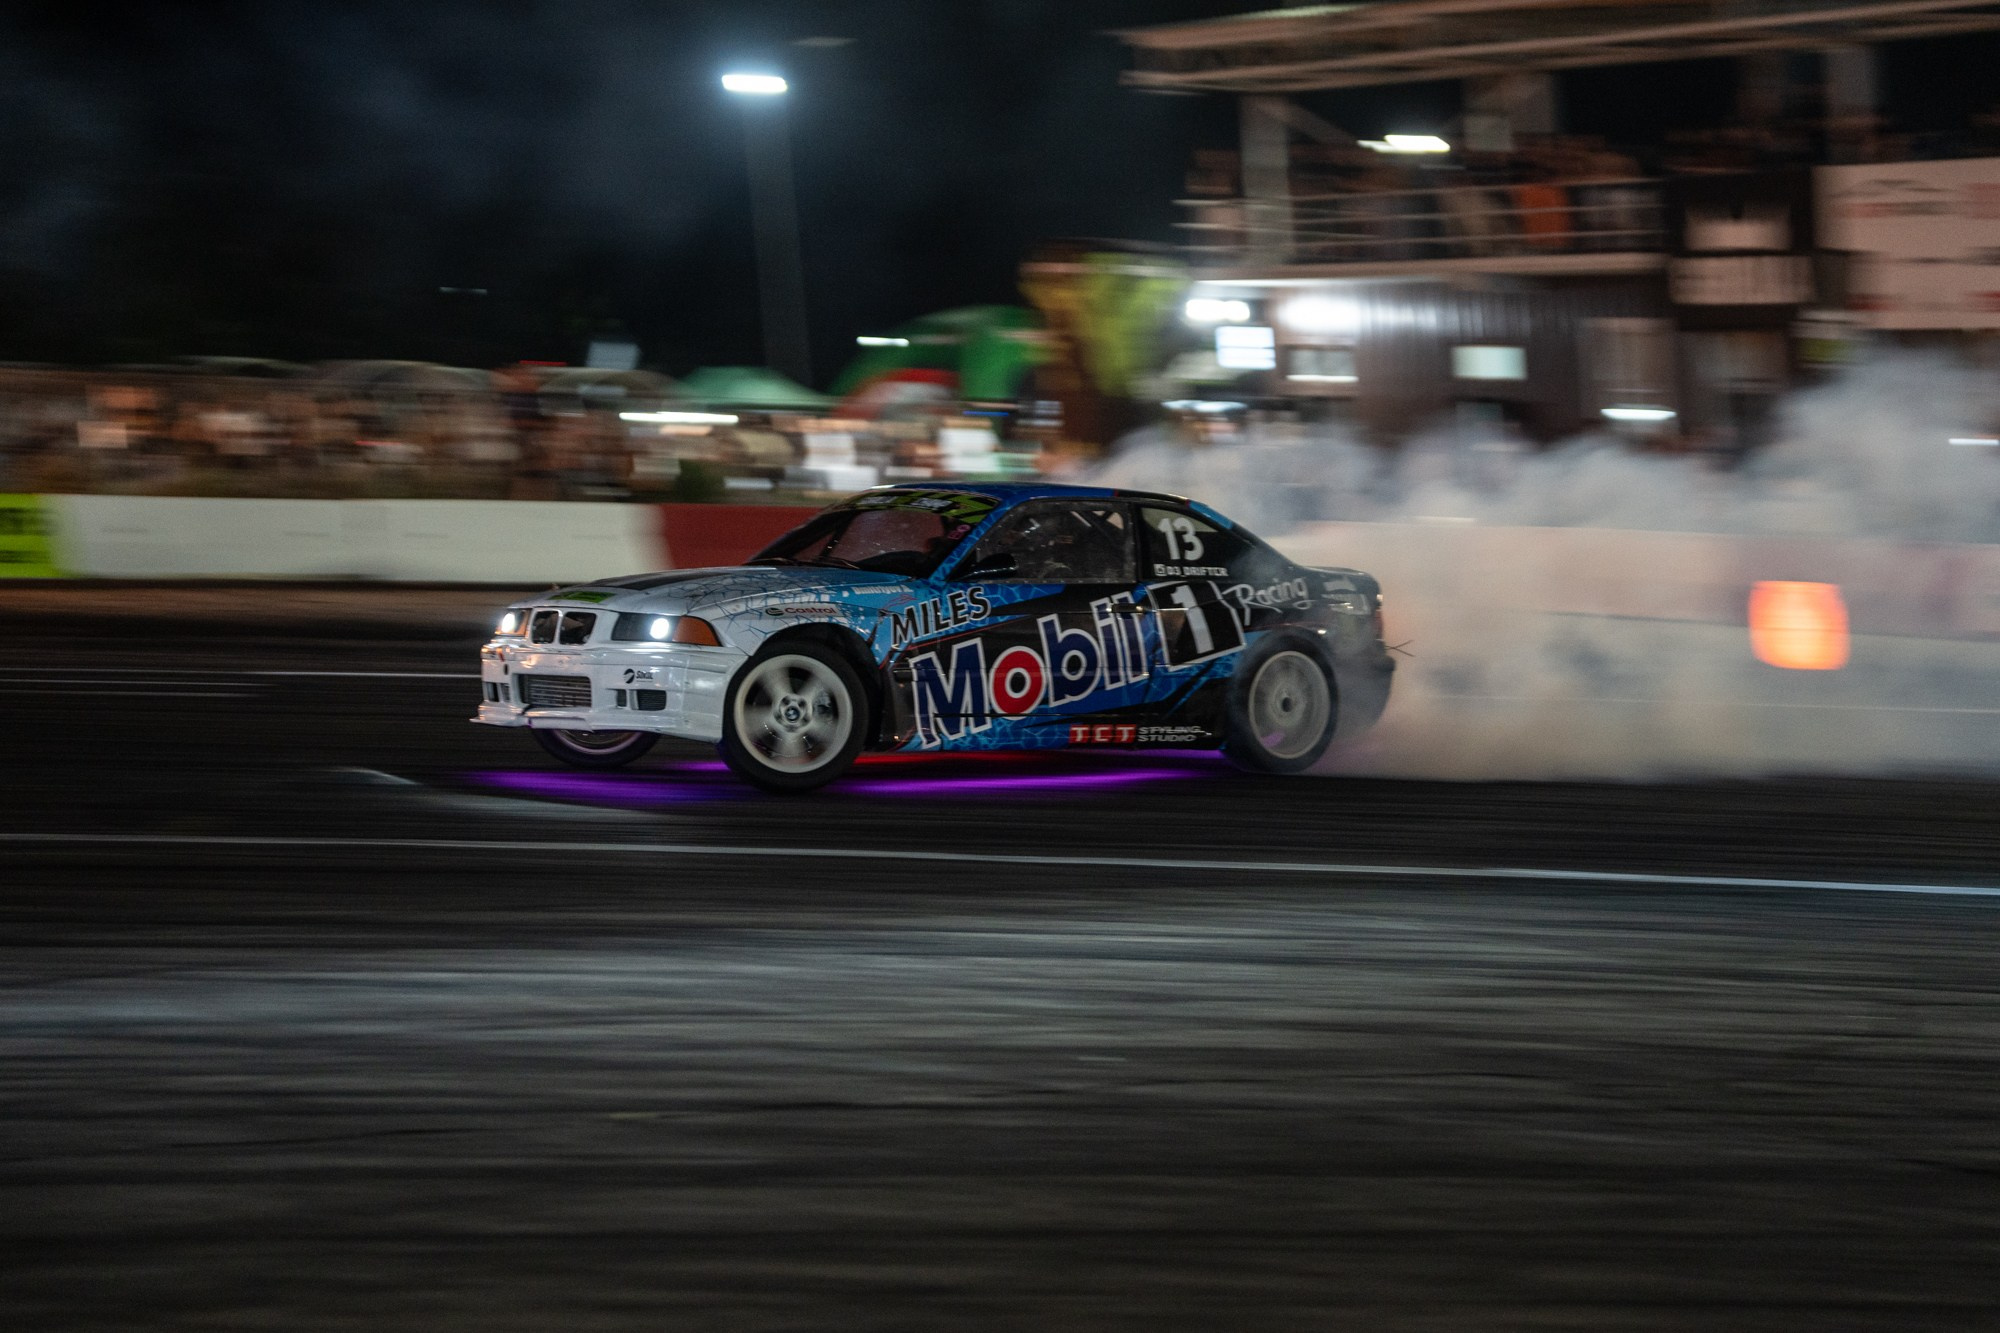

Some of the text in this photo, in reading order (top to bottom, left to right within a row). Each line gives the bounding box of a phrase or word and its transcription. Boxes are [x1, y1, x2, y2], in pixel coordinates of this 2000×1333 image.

[1157, 517, 1205, 561] 13
[891, 586, 992, 650] MILES
[1220, 576, 1319, 626] Racing
[908, 591, 1150, 750] Mobil
[1071, 726, 1136, 743] TCT
[1137, 734, 1198, 743] STUDIO
